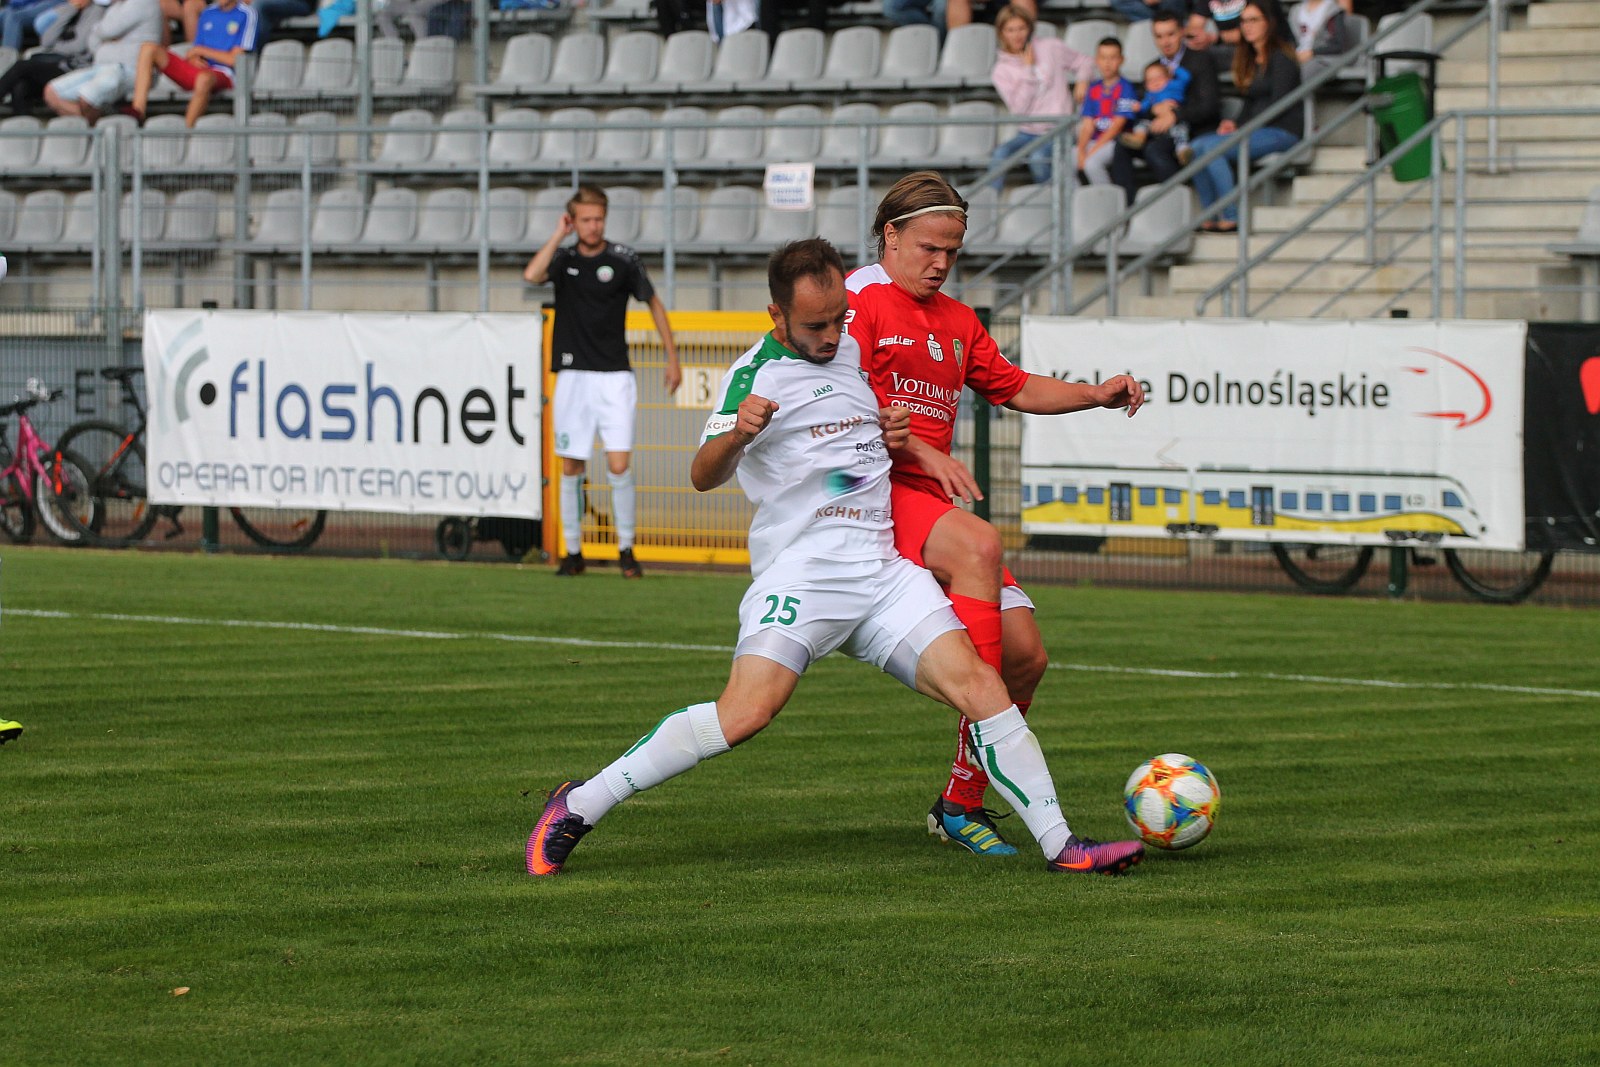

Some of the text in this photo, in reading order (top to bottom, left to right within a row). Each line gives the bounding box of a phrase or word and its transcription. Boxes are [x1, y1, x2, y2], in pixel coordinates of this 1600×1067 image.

[697, 369, 710, 403] 3
[812, 384, 834, 398] JAKO
[890, 371, 945, 401] VOTUM
[1168, 368, 1389, 417] Dolnośląskie
[229, 359, 525, 446] flashnet
[706, 420, 737, 430] KGHM
[158, 460, 528, 501] OPERATOR INTERNETOWY
[815, 506, 861, 520] KGHM
[759, 594, 802, 626] 25
